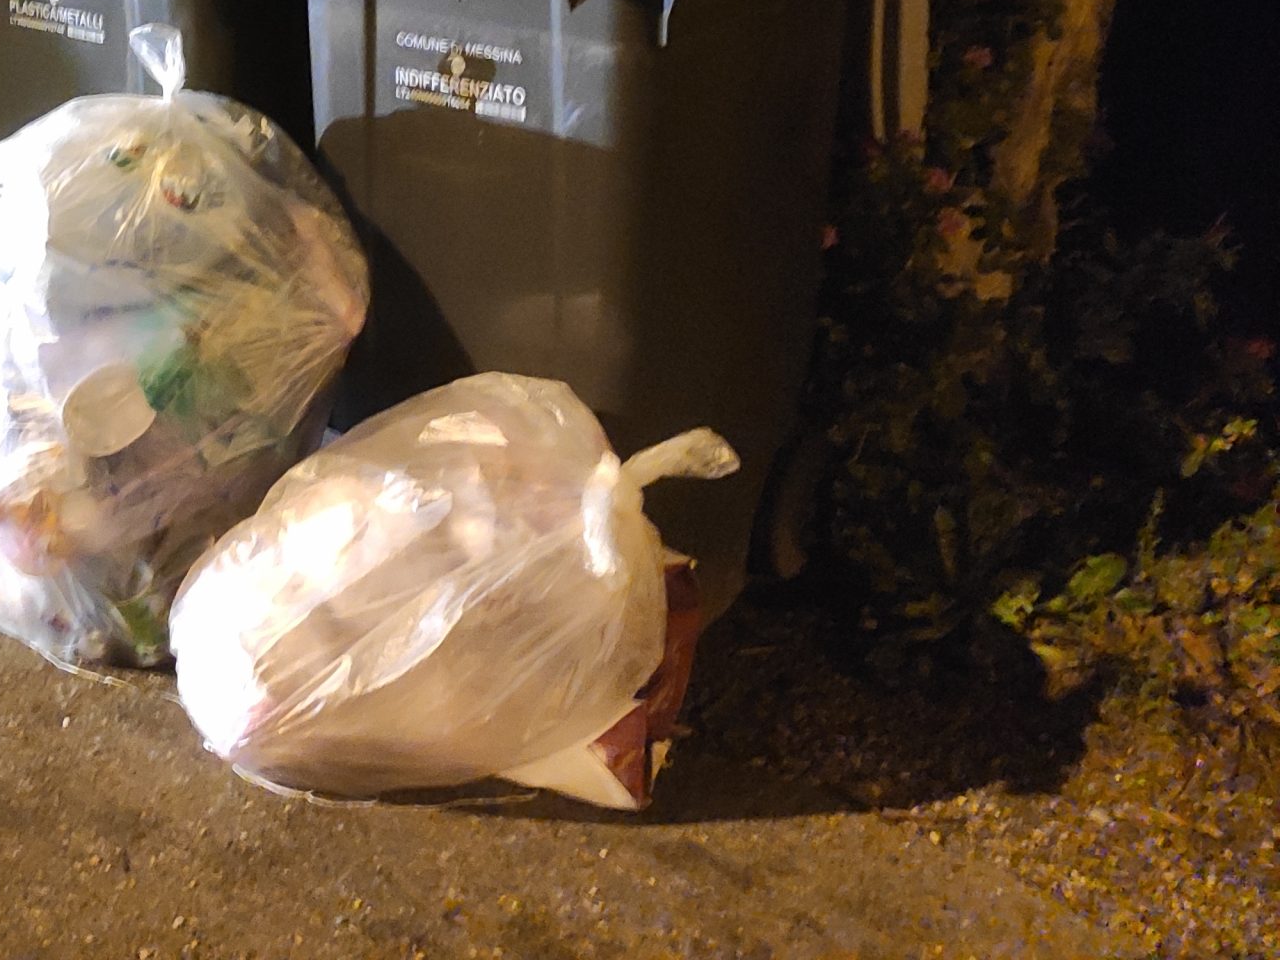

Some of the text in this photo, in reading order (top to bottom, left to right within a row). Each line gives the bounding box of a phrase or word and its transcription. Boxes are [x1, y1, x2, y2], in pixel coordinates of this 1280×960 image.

[396, 31, 449, 53] COMUNE
[465, 41, 523, 65] MESSINA
[395, 66, 526, 106] INDIFFERENZIATO
